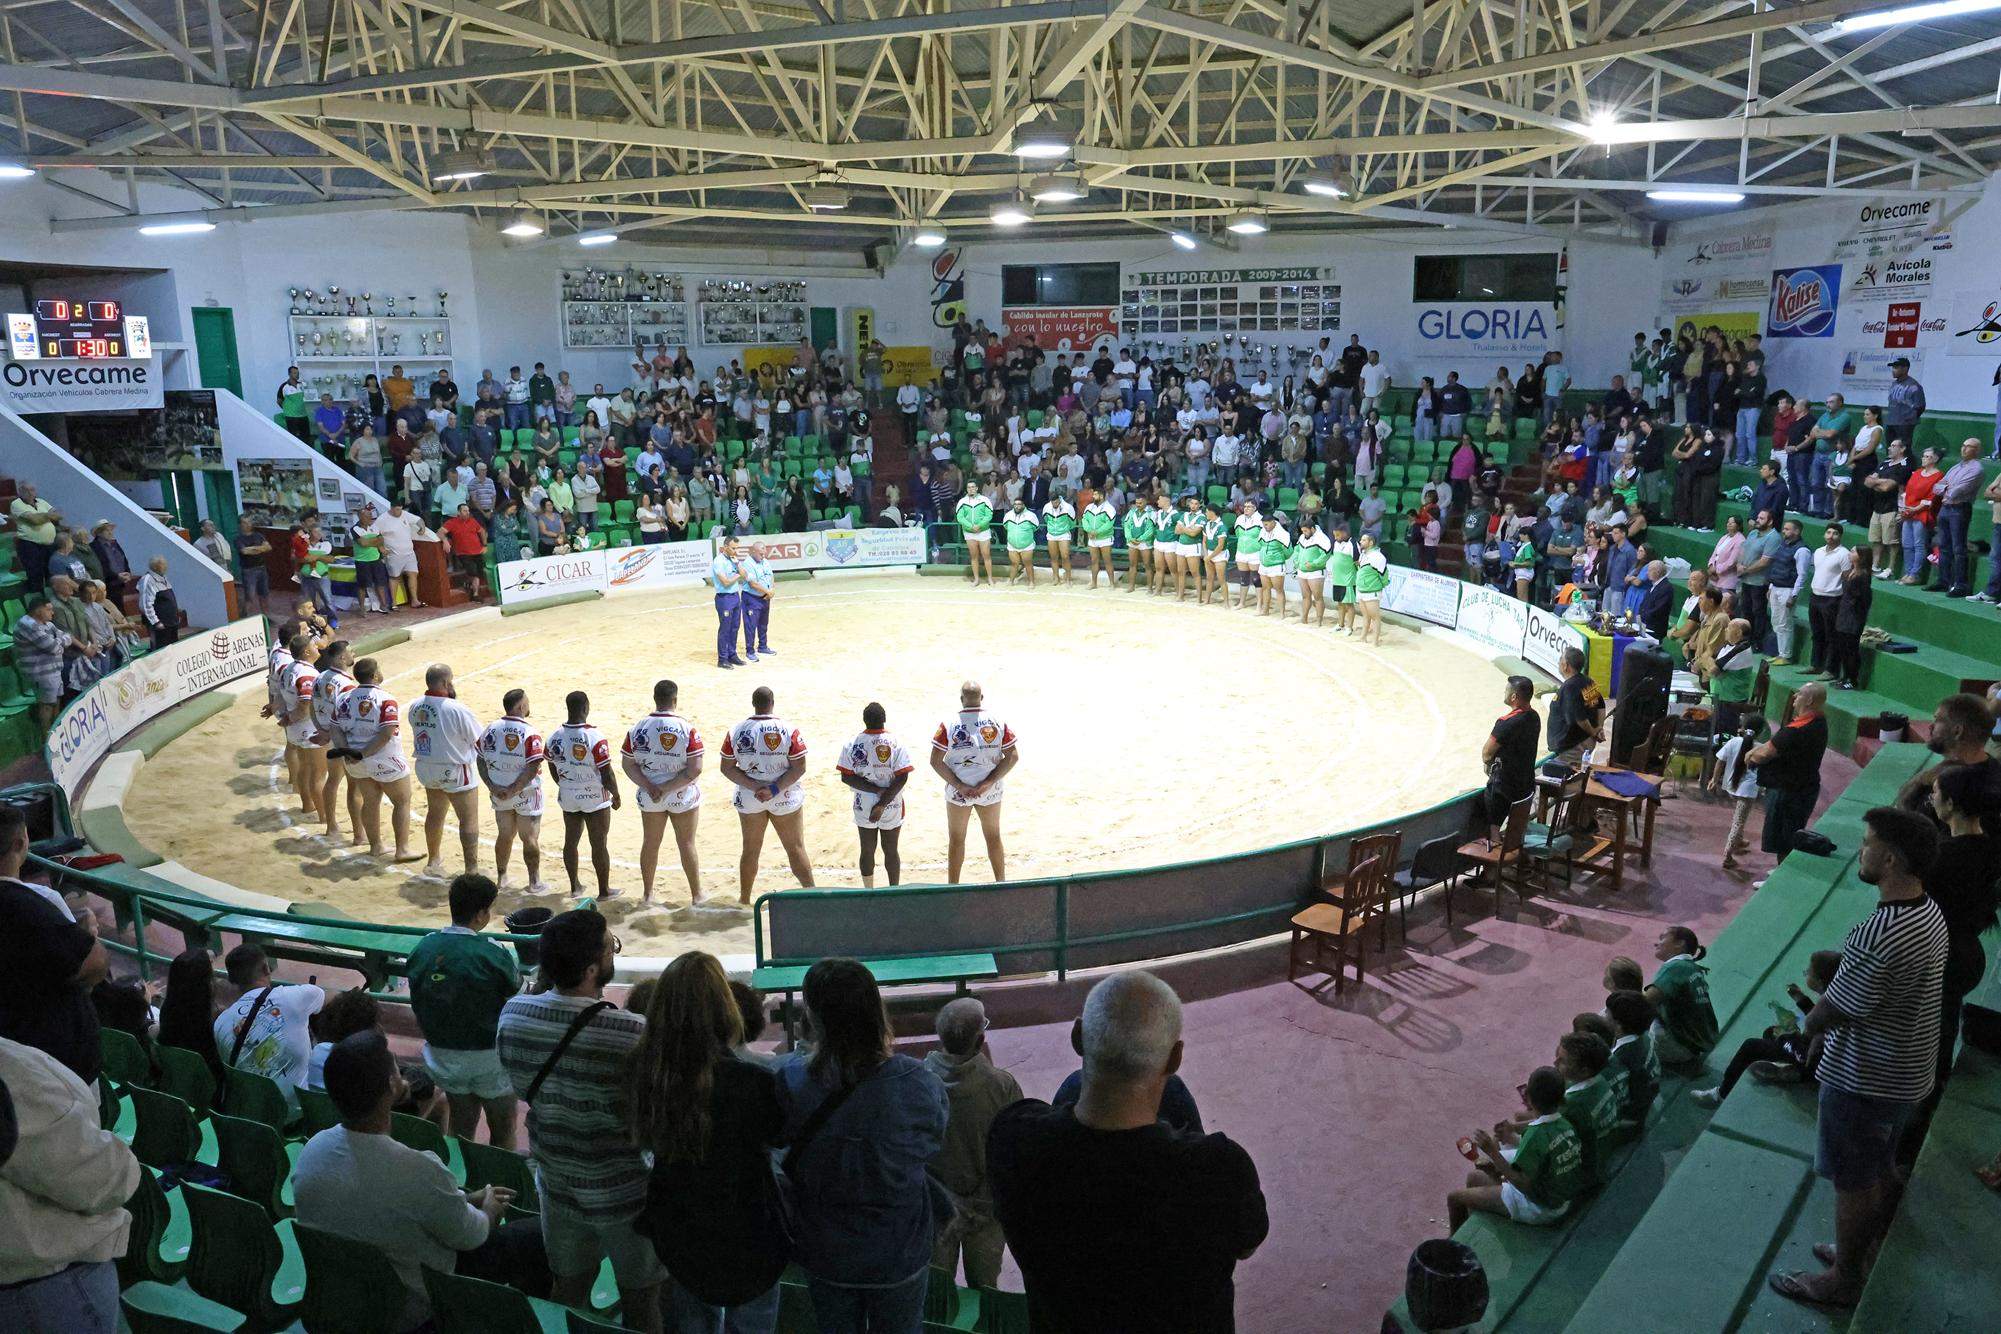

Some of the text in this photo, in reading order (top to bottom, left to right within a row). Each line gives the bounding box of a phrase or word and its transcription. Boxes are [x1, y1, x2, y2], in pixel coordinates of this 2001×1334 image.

[1860, 200, 1931, 222] Orvecame
[1887, 258, 1931, 272] Avícola
[1149, 269, 1312, 285] TEMPORADA 2009-2014
[1885, 271, 1931, 284] Morales
[1775, 276, 1820, 324] Kalise
[56, 303, 65, 318] 0
[74, 304, 83, 318] 2
[104, 303, 114, 319] 0
[1009, 311, 1034, 319] Cabildo
[1014, 320, 1103, 333] con lo nuestro
[1418, 309, 1548, 340] GLORIA
[48, 342, 57, 355] 0
[77, 340, 105, 356] 1:30
[110, 342, 118, 354] 0
[3, 363, 147, 387] Orvecame
[9, 387, 57, 400] Organización
[94, 387, 123, 396] Cabrera
[123, 386, 149, 396] Medina
[736, 543, 800, 560] SAR
[546, 560, 593, 581] CICAR
[176, 631, 265, 678] COLEGIO ARENAS
[187, 653, 258, 693] INTERNACIONAL
[59, 696, 105, 763] GLORIA
